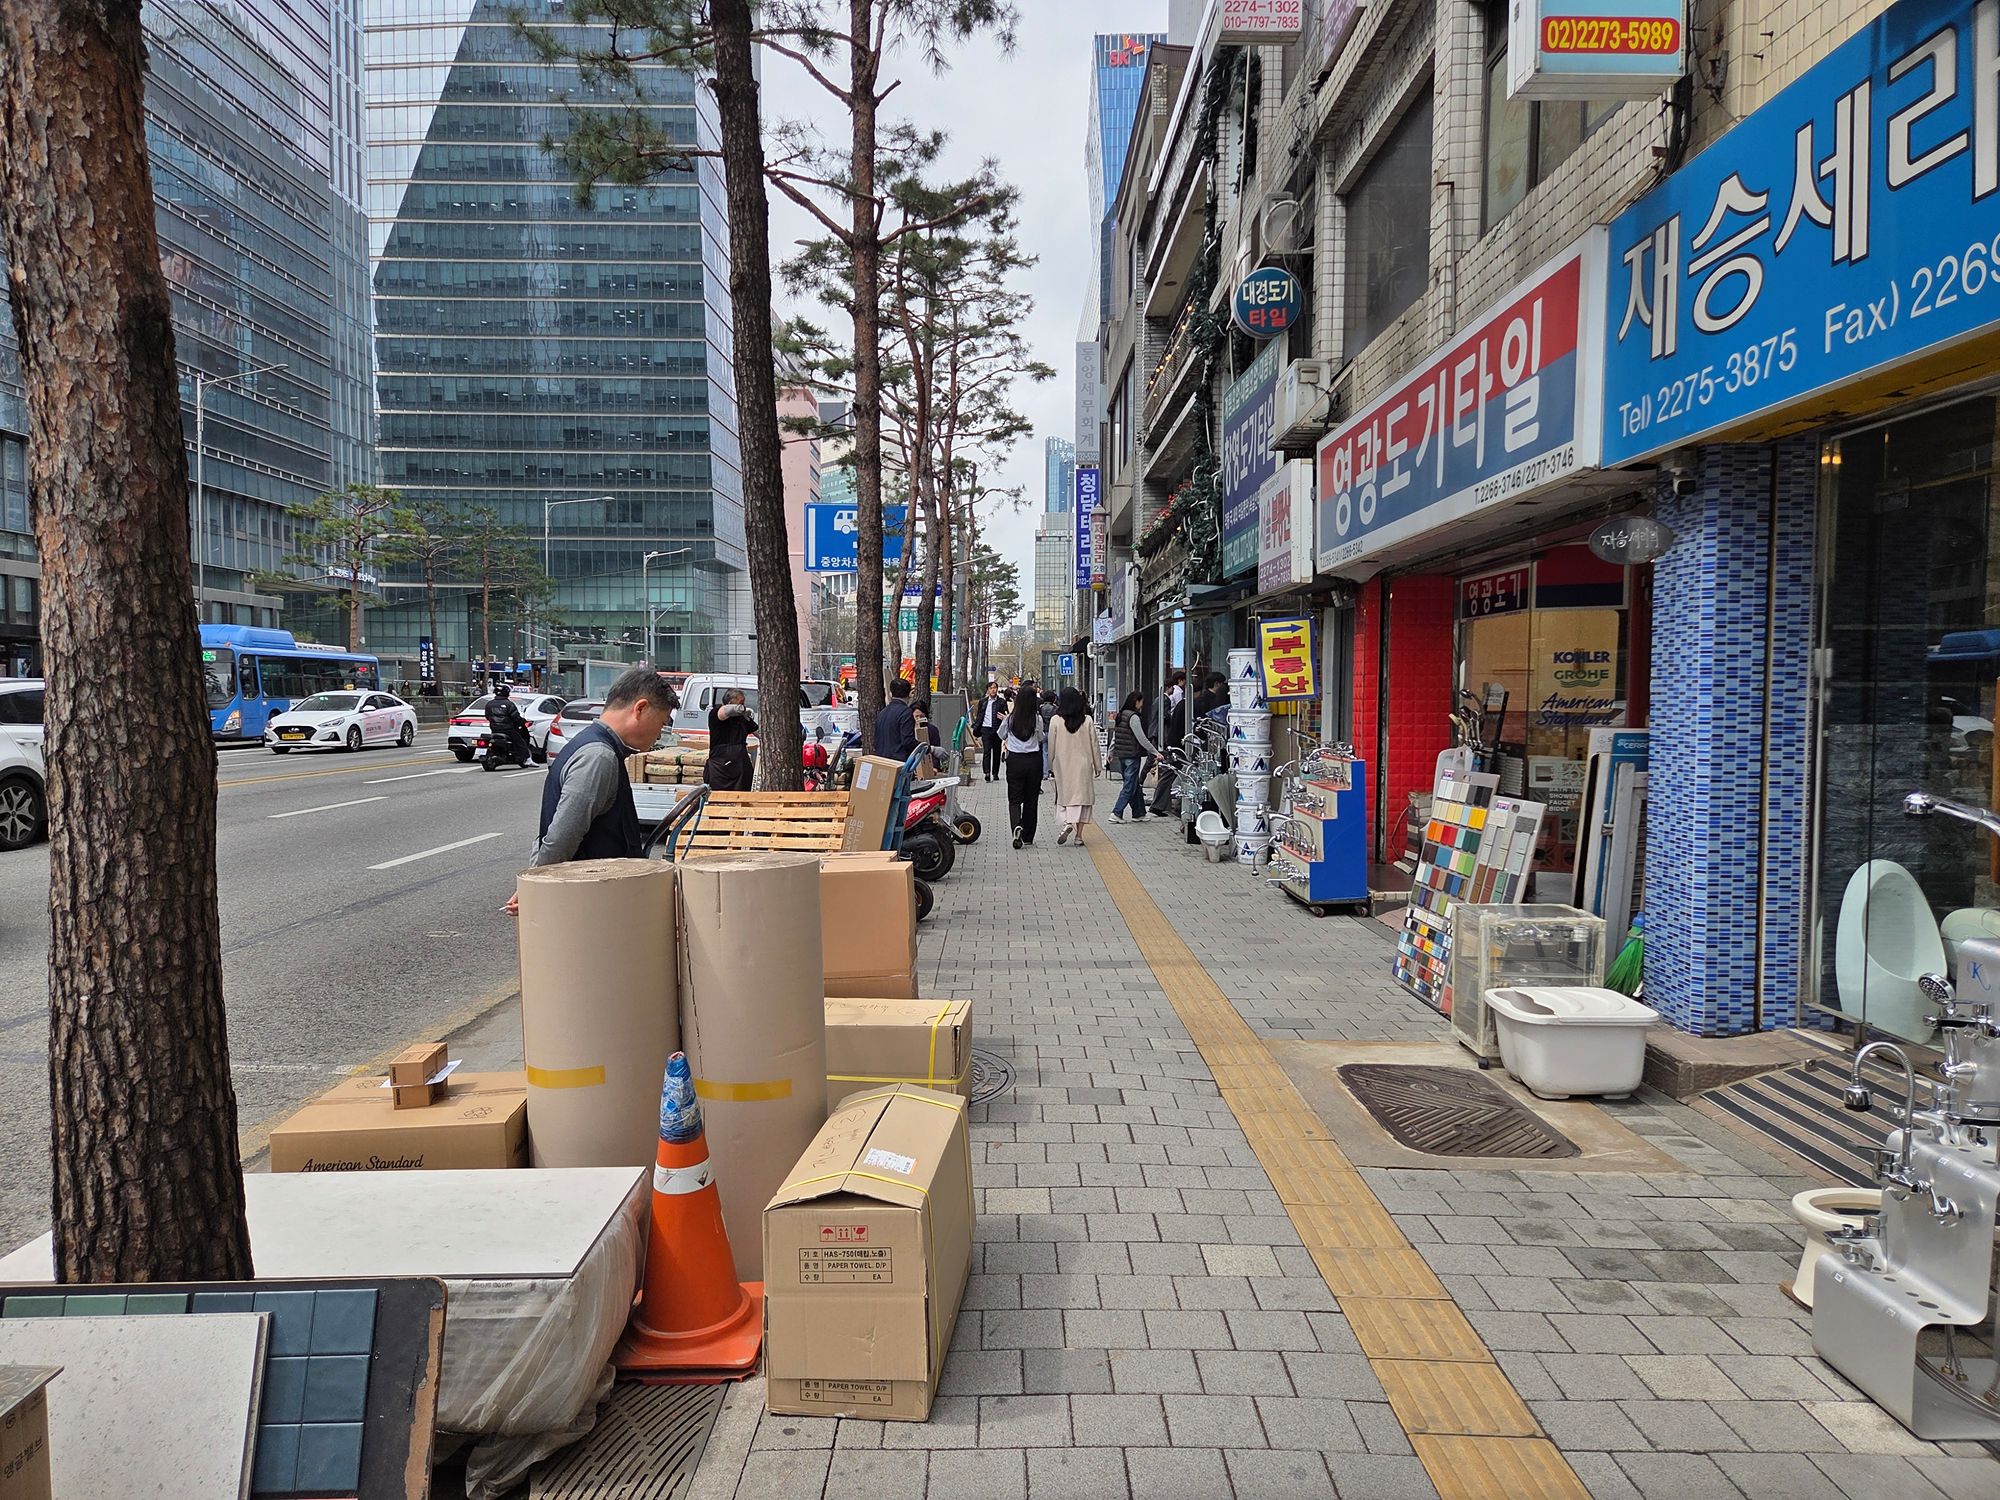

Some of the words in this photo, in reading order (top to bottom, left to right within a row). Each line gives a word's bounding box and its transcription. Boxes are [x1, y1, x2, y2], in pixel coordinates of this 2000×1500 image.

[1224, 0, 1299, 13] 2274-1302
[1224, 16, 1299, 29] 010-7797-7835
[1546, 20, 1673, 50] 02)2273-5989
[1110, 51, 1130, 68] SK
[1242, 279, 1294, 305] 대경도기
[1249, 307, 1287, 328] 타일
[1656, 328, 1798, 424] 2275-3875
[1824, 281, 1899, 354] Fax)
[1080, 347, 1096, 447] 동양세무회계
[1331, 297, 1542, 537] 영광도기타일
[1468, 572, 1521, 616] 영광도기
[1268, 636, 1309, 695] 부동산
[1553, 651, 1610, 665] KOHLER
[1553, 669, 1610, 681] GROHE
[1541, 692, 1614, 710] American
[1535, 710, 1614, 727] Standard
[1549, 792, 1579, 800] SHOWER
[301, 1157, 362, 1172] American
[366, 1154, 424, 1169] Standard
[875, 1262, 887, 1270] D/P
[828, 1382, 849, 1390] PAPER
[4, 1437, 44, 1480] 앵글밸브
